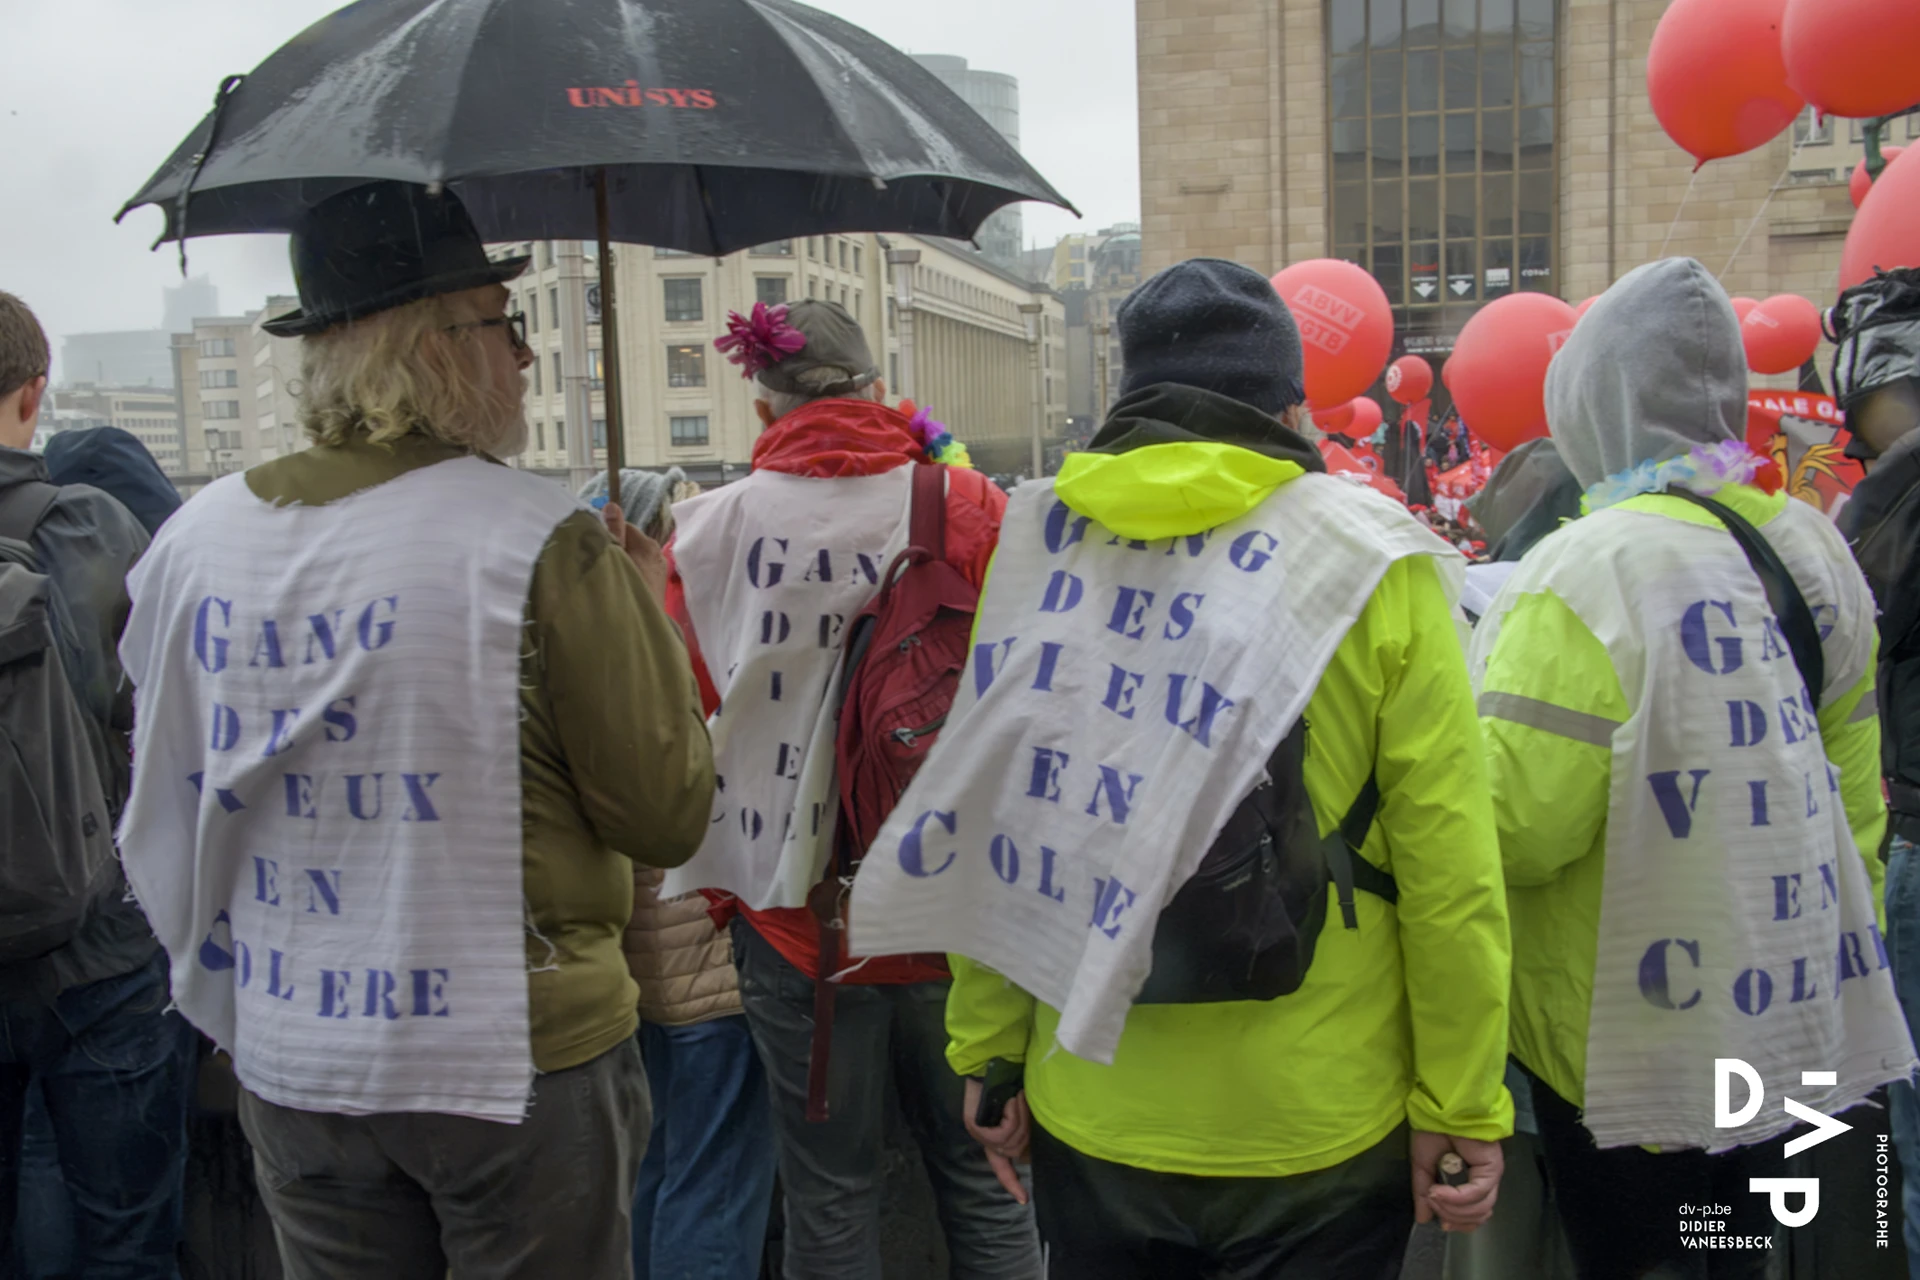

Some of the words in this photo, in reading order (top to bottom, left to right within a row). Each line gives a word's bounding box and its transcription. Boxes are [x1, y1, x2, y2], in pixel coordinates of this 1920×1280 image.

[746, 536, 883, 589] GAN
[193, 595, 398, 674] GANG
[760, 610, 844, 649] DE
[1037, 570, 1206, 641] DES
[210, 695, 357, 757] DES
[1025, 746, 1144, 825] EN
[252, 855, 342, 916] EN
[897, 810, 1137, 940] COLE
[1772, 859, 1838, 921] EN
